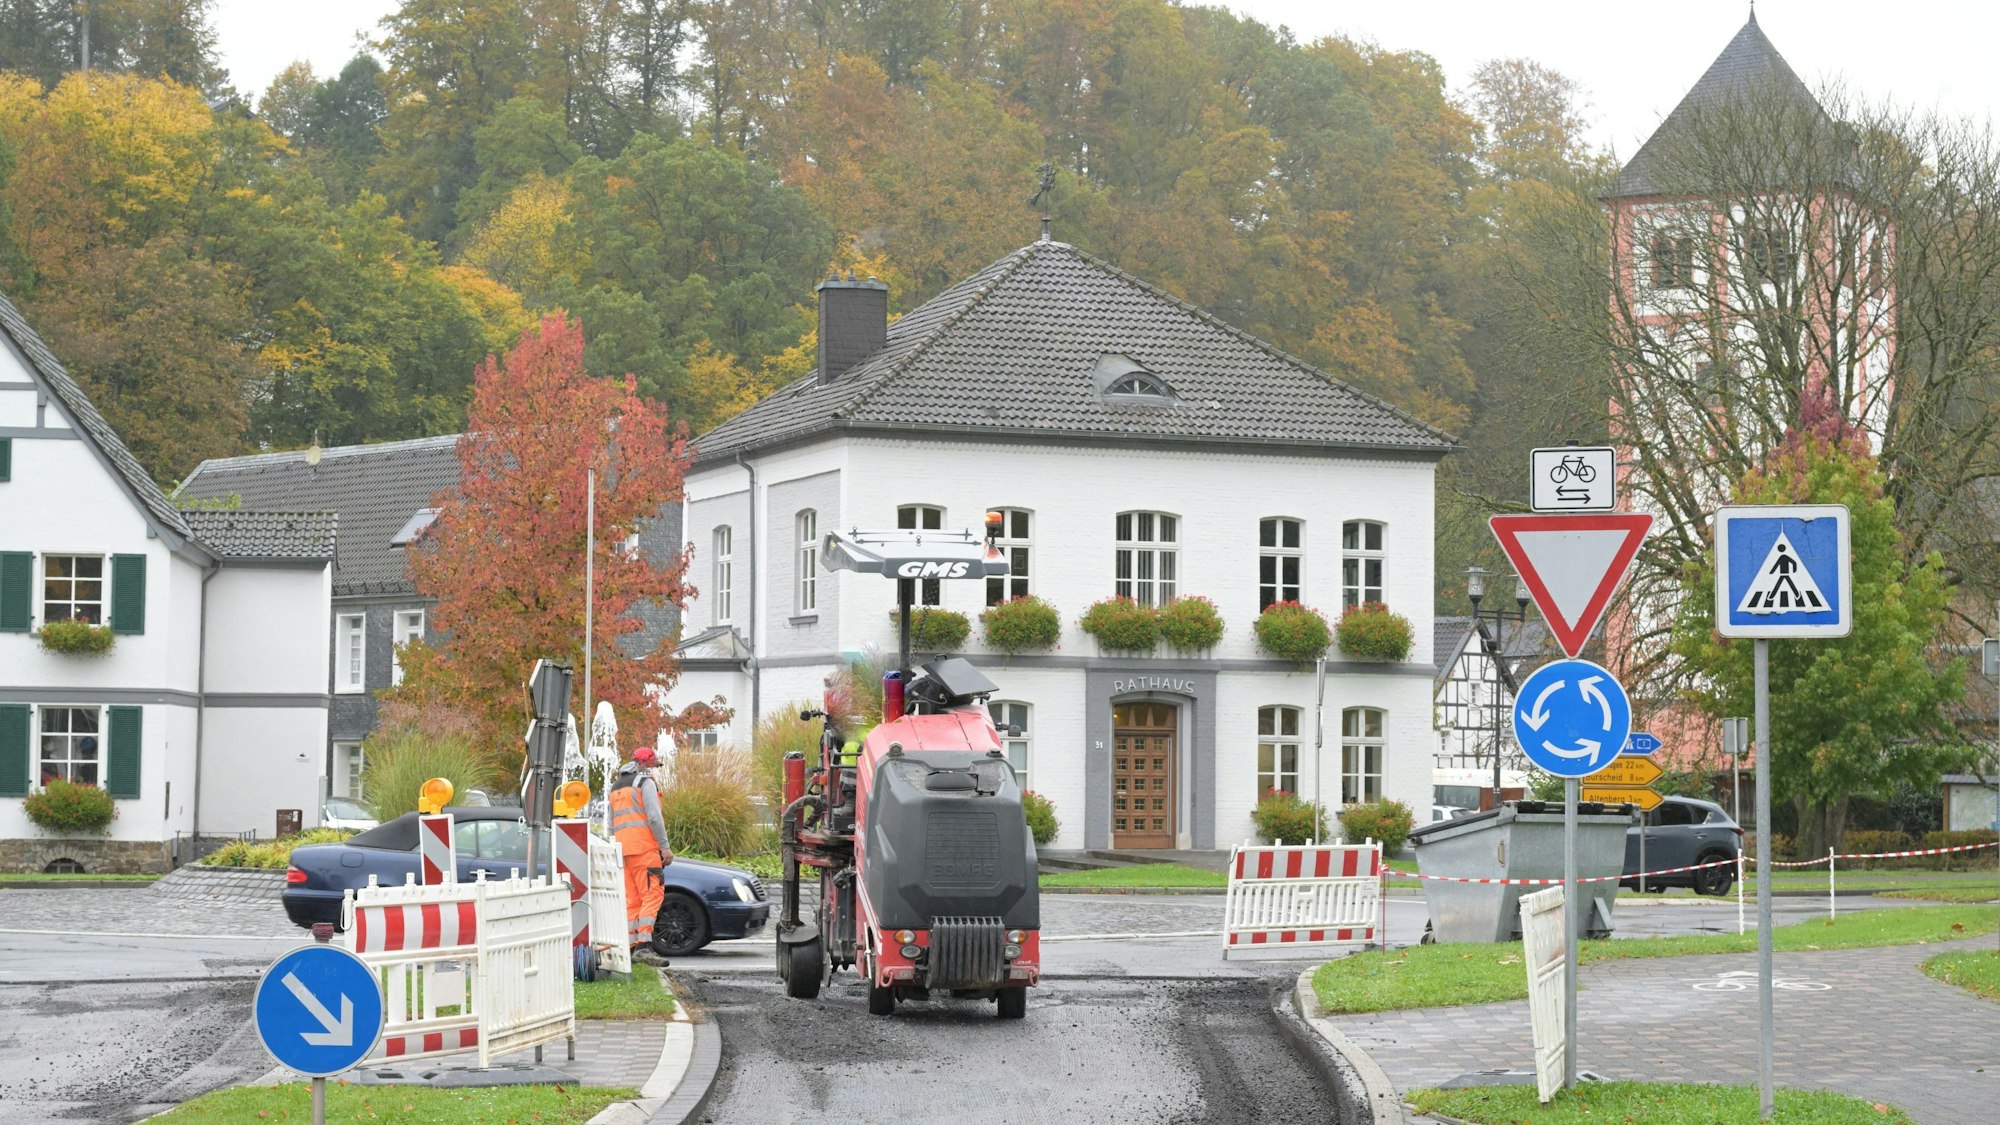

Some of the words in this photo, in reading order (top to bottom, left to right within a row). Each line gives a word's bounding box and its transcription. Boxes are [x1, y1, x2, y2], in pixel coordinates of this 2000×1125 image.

[898, 562, 969, 578] GMS
[1114, 677, 1195, 694] RATHAUS
[1095, 741, 1103, 749] 31
[1626, 761, 1634, 769] 22
[1629, 774, 1634, 782] 8
[1589, 795, 1625, 803] Altenberg
[1628, 795, 1633, 803] 3
